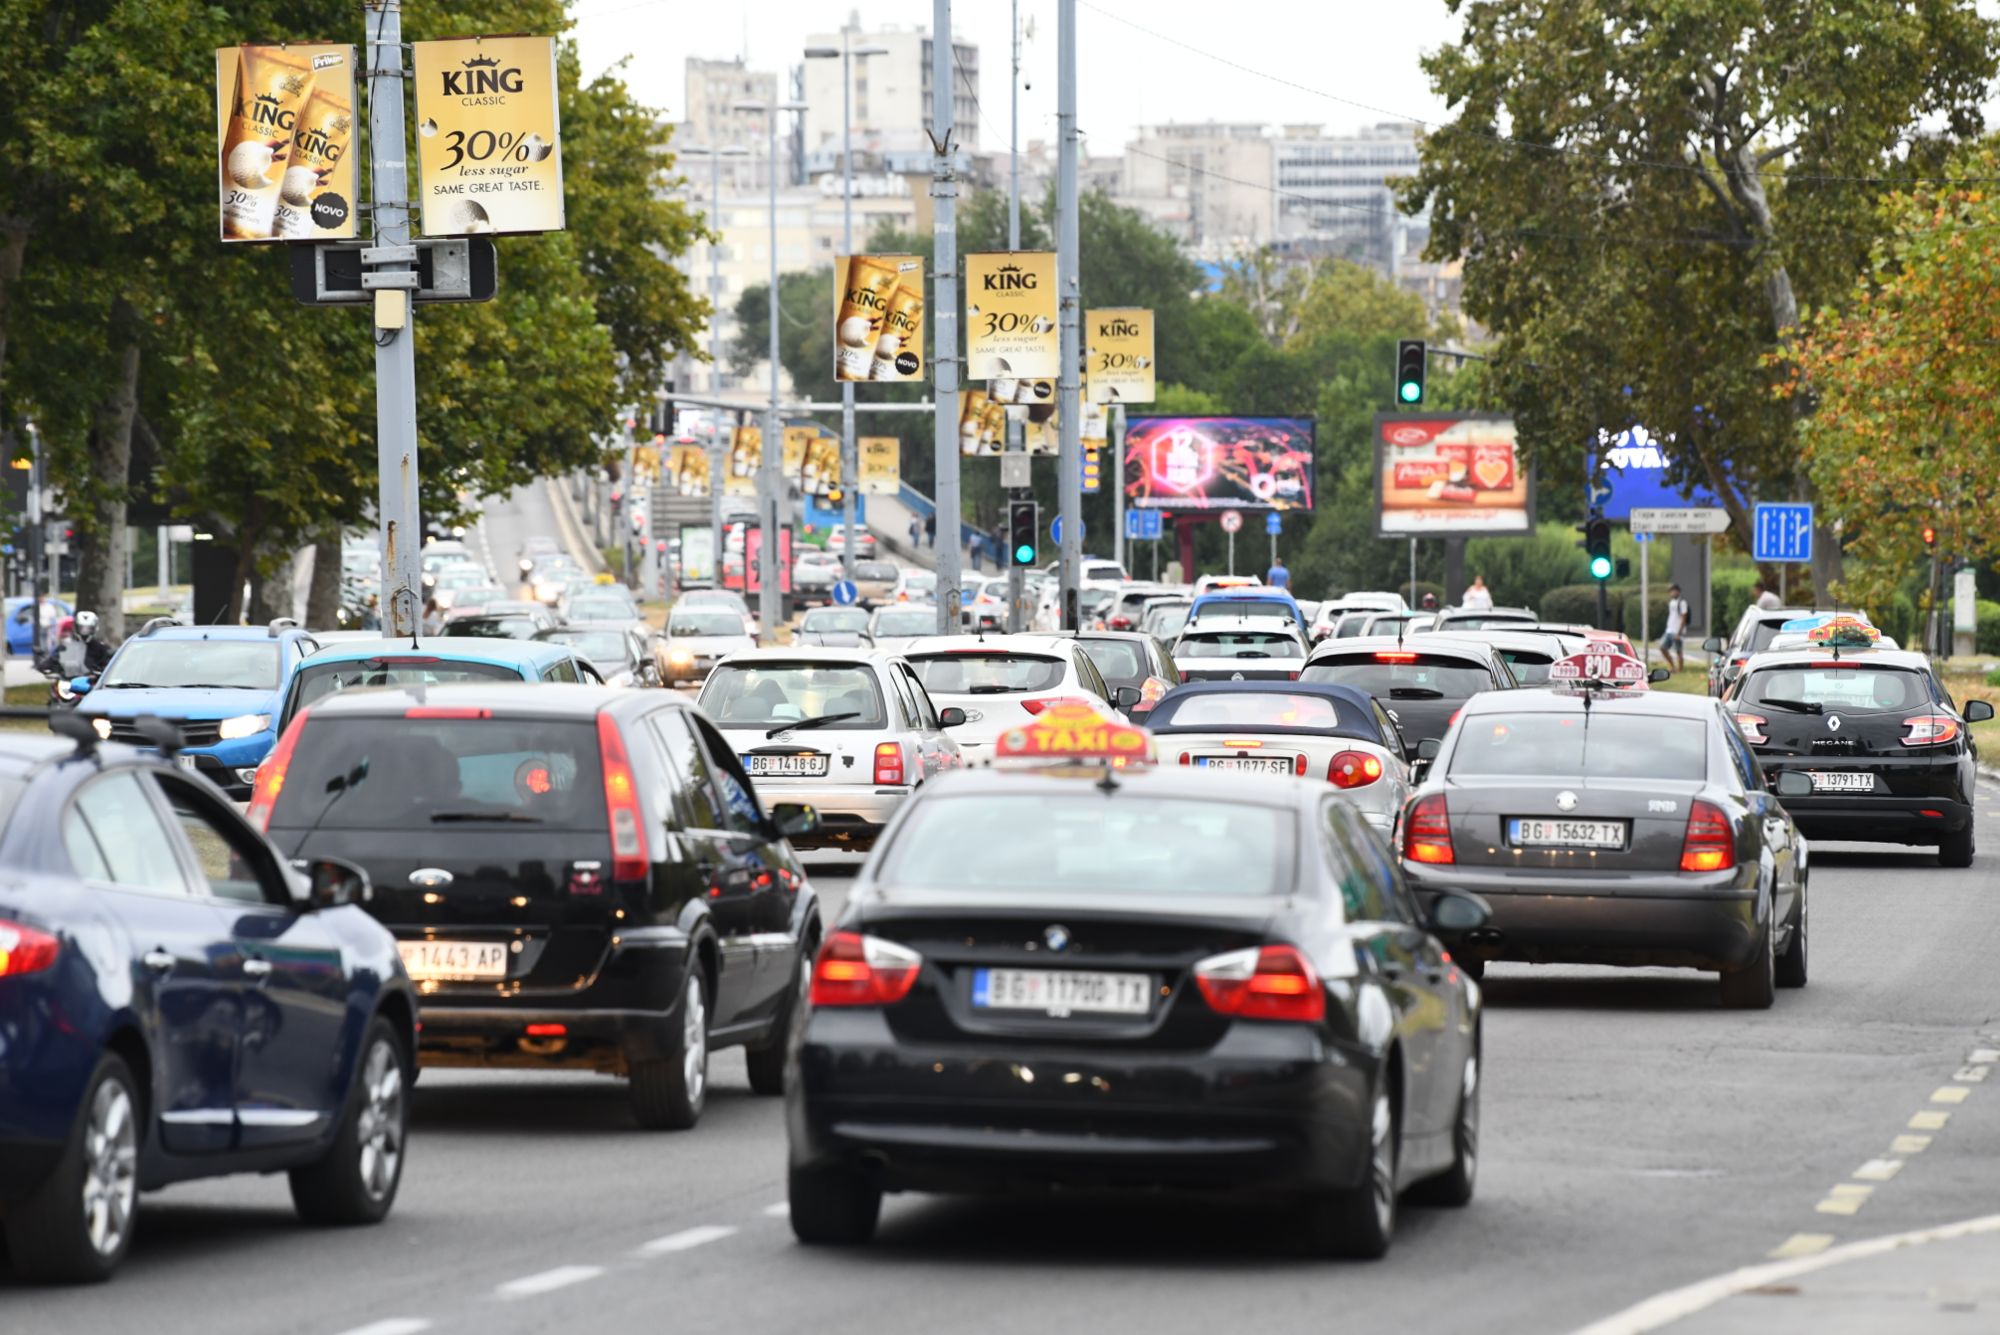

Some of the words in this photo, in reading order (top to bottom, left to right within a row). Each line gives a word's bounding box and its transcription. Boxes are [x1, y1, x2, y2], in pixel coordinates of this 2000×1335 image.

[441, 68, 524, 96] KING
[461, 96, 506, 106] CLASSIC
[294, 129, 340, 162] KING
[440, 130, 530, 170] 30%
[459, 166, 485, 177] less
[489, 165, 529, 178] sugar
[434, 184, 465, 195] SAME
[469, 182, 504, 193] GREAT
[314, 203, 344, 218] NOVO
[983, 273, 1037, 290] KING
[847, 288, 886, 311] KING
[885, 311, 915, 332] KING
[981, 312, 1039, 338] 30%
[1100, 324, 1139, 336] KING
[897, 358, 917, 369] NOVO
[1097, 352, 1140, 372] 30%
[1033, 729, 1109, 752] TAXI
[752, 757, 768, 770] BG
[1521, 823, 1543, 840] BG
